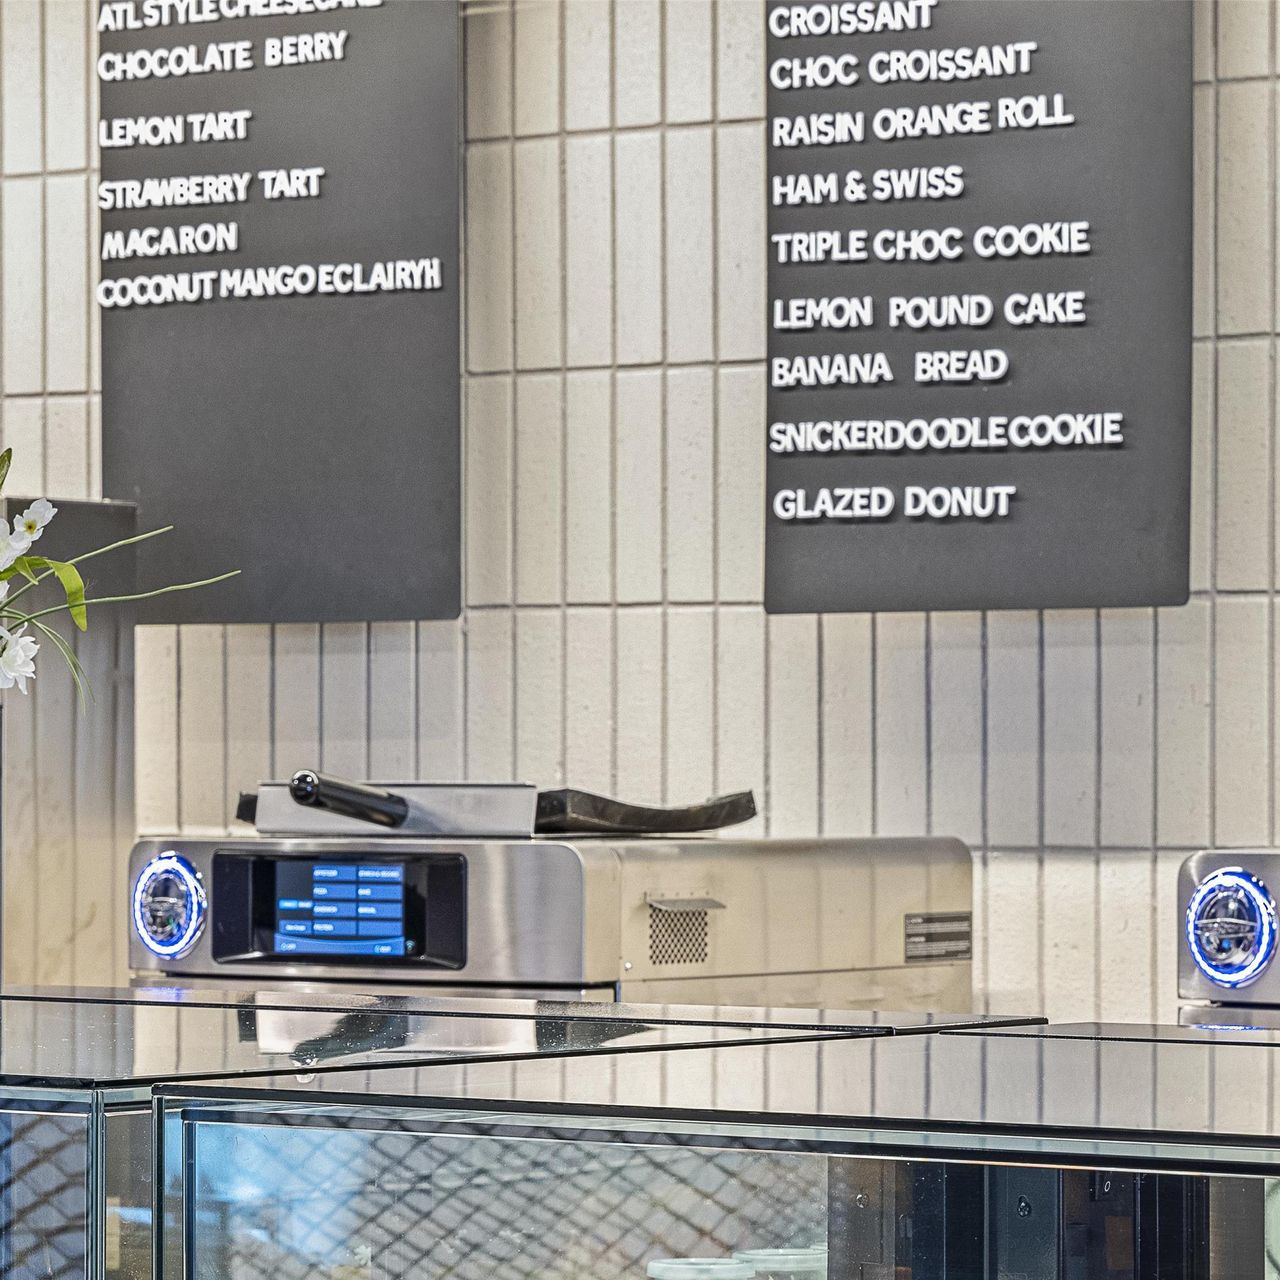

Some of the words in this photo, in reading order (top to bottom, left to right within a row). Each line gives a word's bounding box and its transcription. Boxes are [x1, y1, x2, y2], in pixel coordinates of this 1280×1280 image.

[142, 0, 220, 26] STYLE
[768, 0, 938, 38] CROISSANT
[97, 40, 254, 81] CHOCOLATE
[264, 29, 349, 68] BERRY
[769, 54, 859, 90] CHOC
[868, 41, 1038, 84] CROISSANT
[99, 115, 185, 148] LEMON
[187, 109, 253, 143] TART
[772, 112, 864, 148] RAISIN
[872, 101, 991, 141] ORANGE
[997, 94, 1075, 129] ROLL
[97, 172, 252, 210] STRAWBERRY
[258, 167, 326, 199] TART
[772, 172, 838, 206] HAM
[843, 170, 867, 202] &
[872, 165, 964, 200] SWISS
[101, 221, 239, 261] MACARON
[772, 229, 868, 264] TRIPLE
[872, 227, 963, 261] CHOC
[973, 221, 1091, 258] COOKIE
[96, 270, 218, 308] COCONUT
[219, 264, 316, 298] MANGO
[773, 296, 873, 330] LEMON
[888, 294, 993, 328] POUND
[1004, 291, 1086, 326] CAKE
[772, 352, 893, 388] BANANA
[914, 348, 1009, 383] BREAD
[769, 416, 1008, 454] SNICKERDOODLE
[1008, 412, 1124, 448] COOKIE
[773, 487, 895, 521] GLAZED
[904, 484, 1016, 519] DONUT
